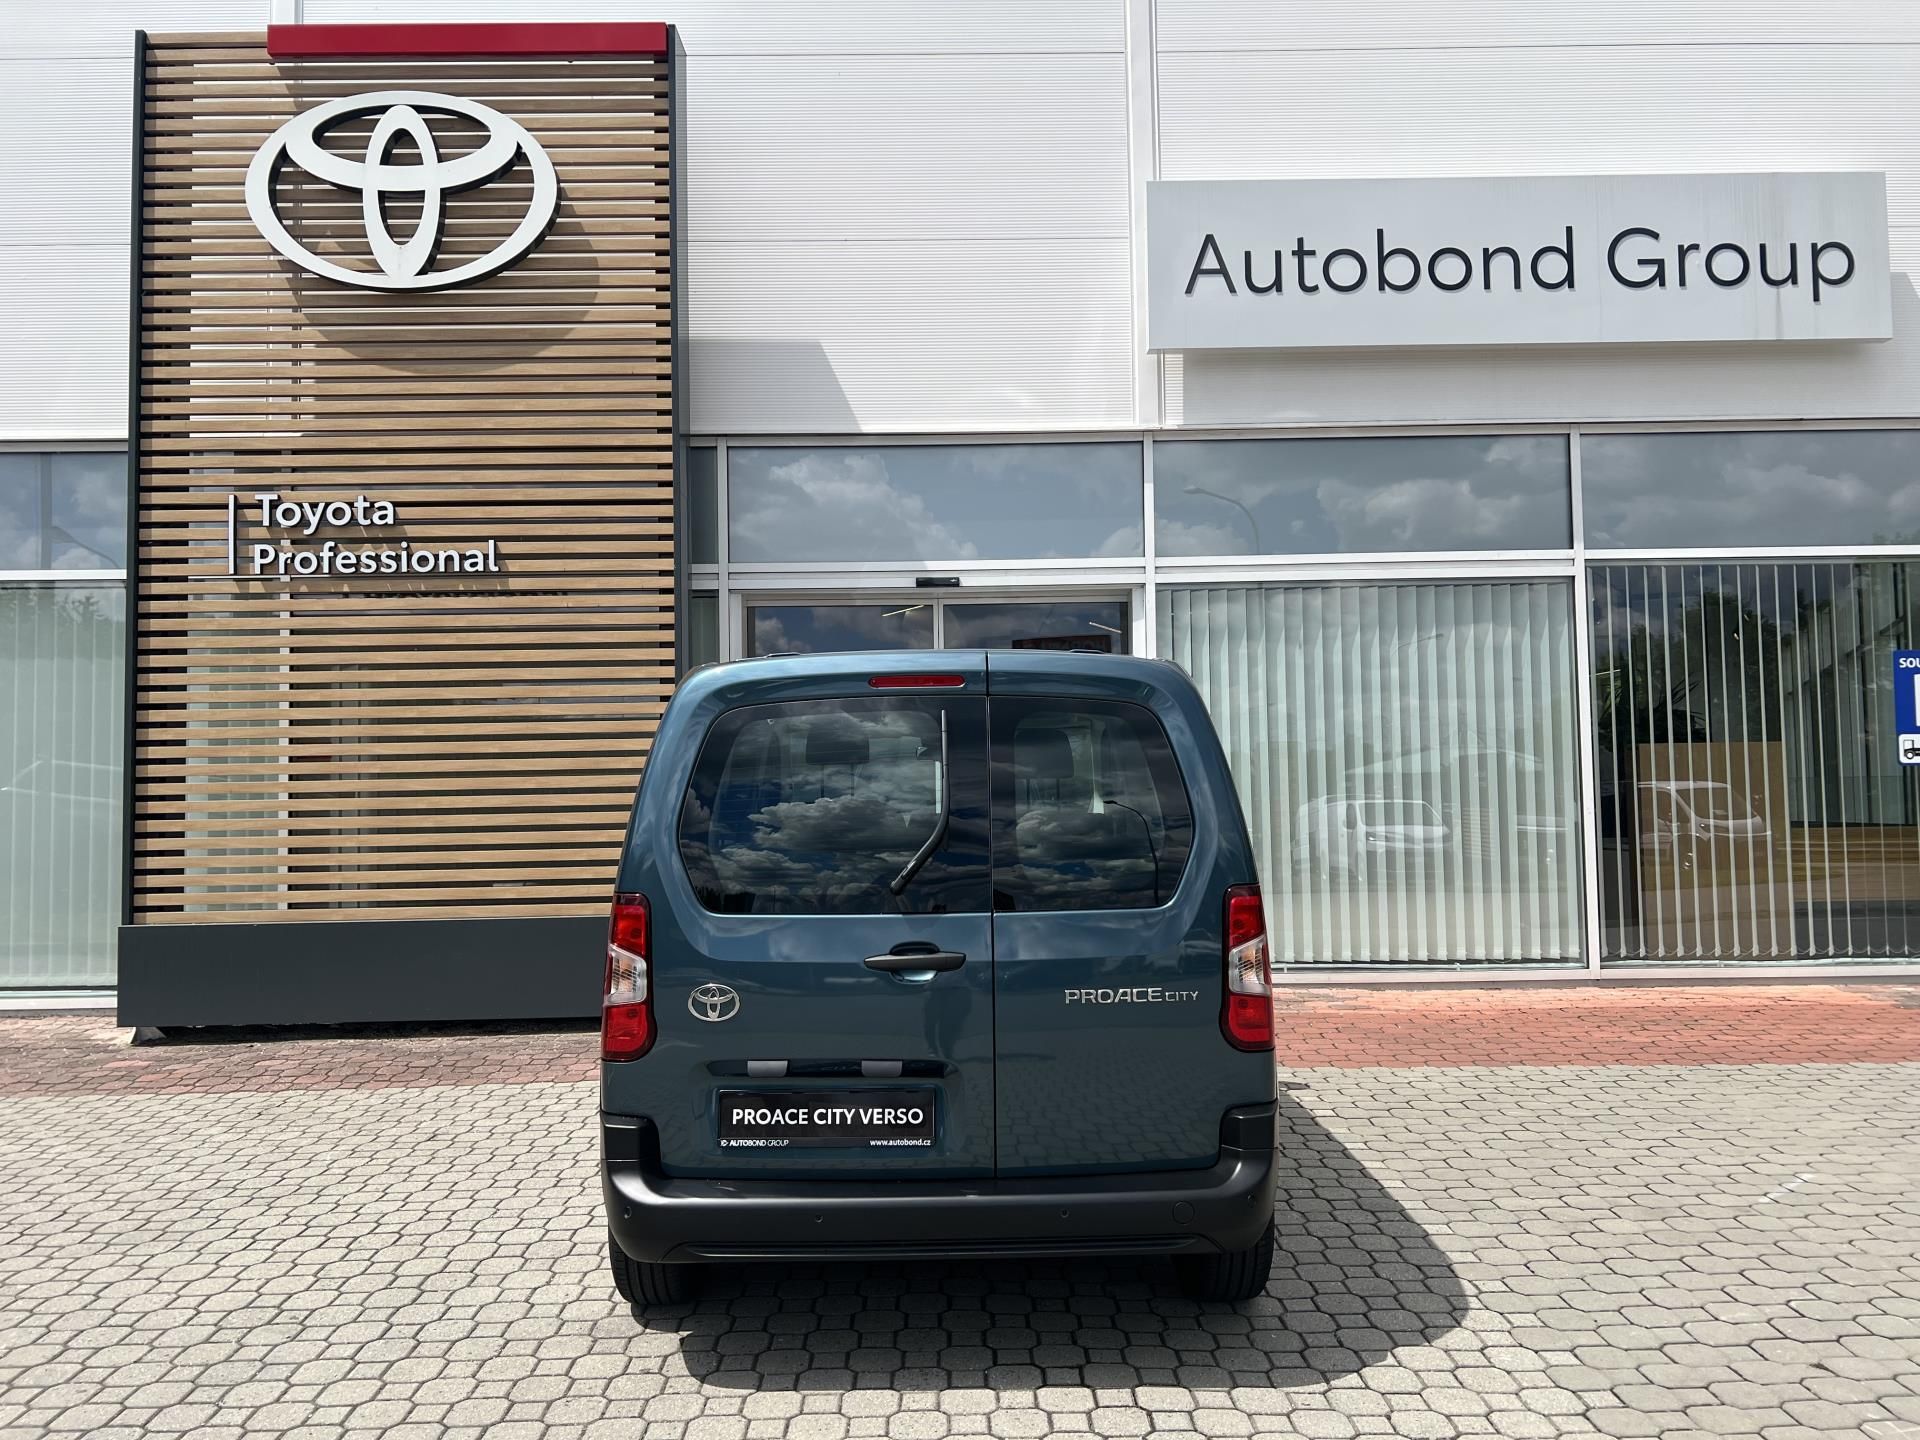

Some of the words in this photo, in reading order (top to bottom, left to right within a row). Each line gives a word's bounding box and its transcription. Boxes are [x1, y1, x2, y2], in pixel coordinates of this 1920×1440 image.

[1185, 226, 1576, 296] Autobond
[1607, 227, 1856, 303] Group
[254, 493, 396, 535] Toyota
[253, 539, 500, 575] Professional
[1064, 987, 1163, 1004] PROACE
[1165, 991, 1199, 1002] CITY
[732, 1108, 809, 1125] PROACE
[813, 1108, 856, 1125] CITY
[859, 1108, 924, 1125] VERSO
[729, 1139, 767, 1147] AUTOBOND
[767, 1139, 789, 1147] GROUP
[869, 1138, 931, 1146] www.autobond.cz
